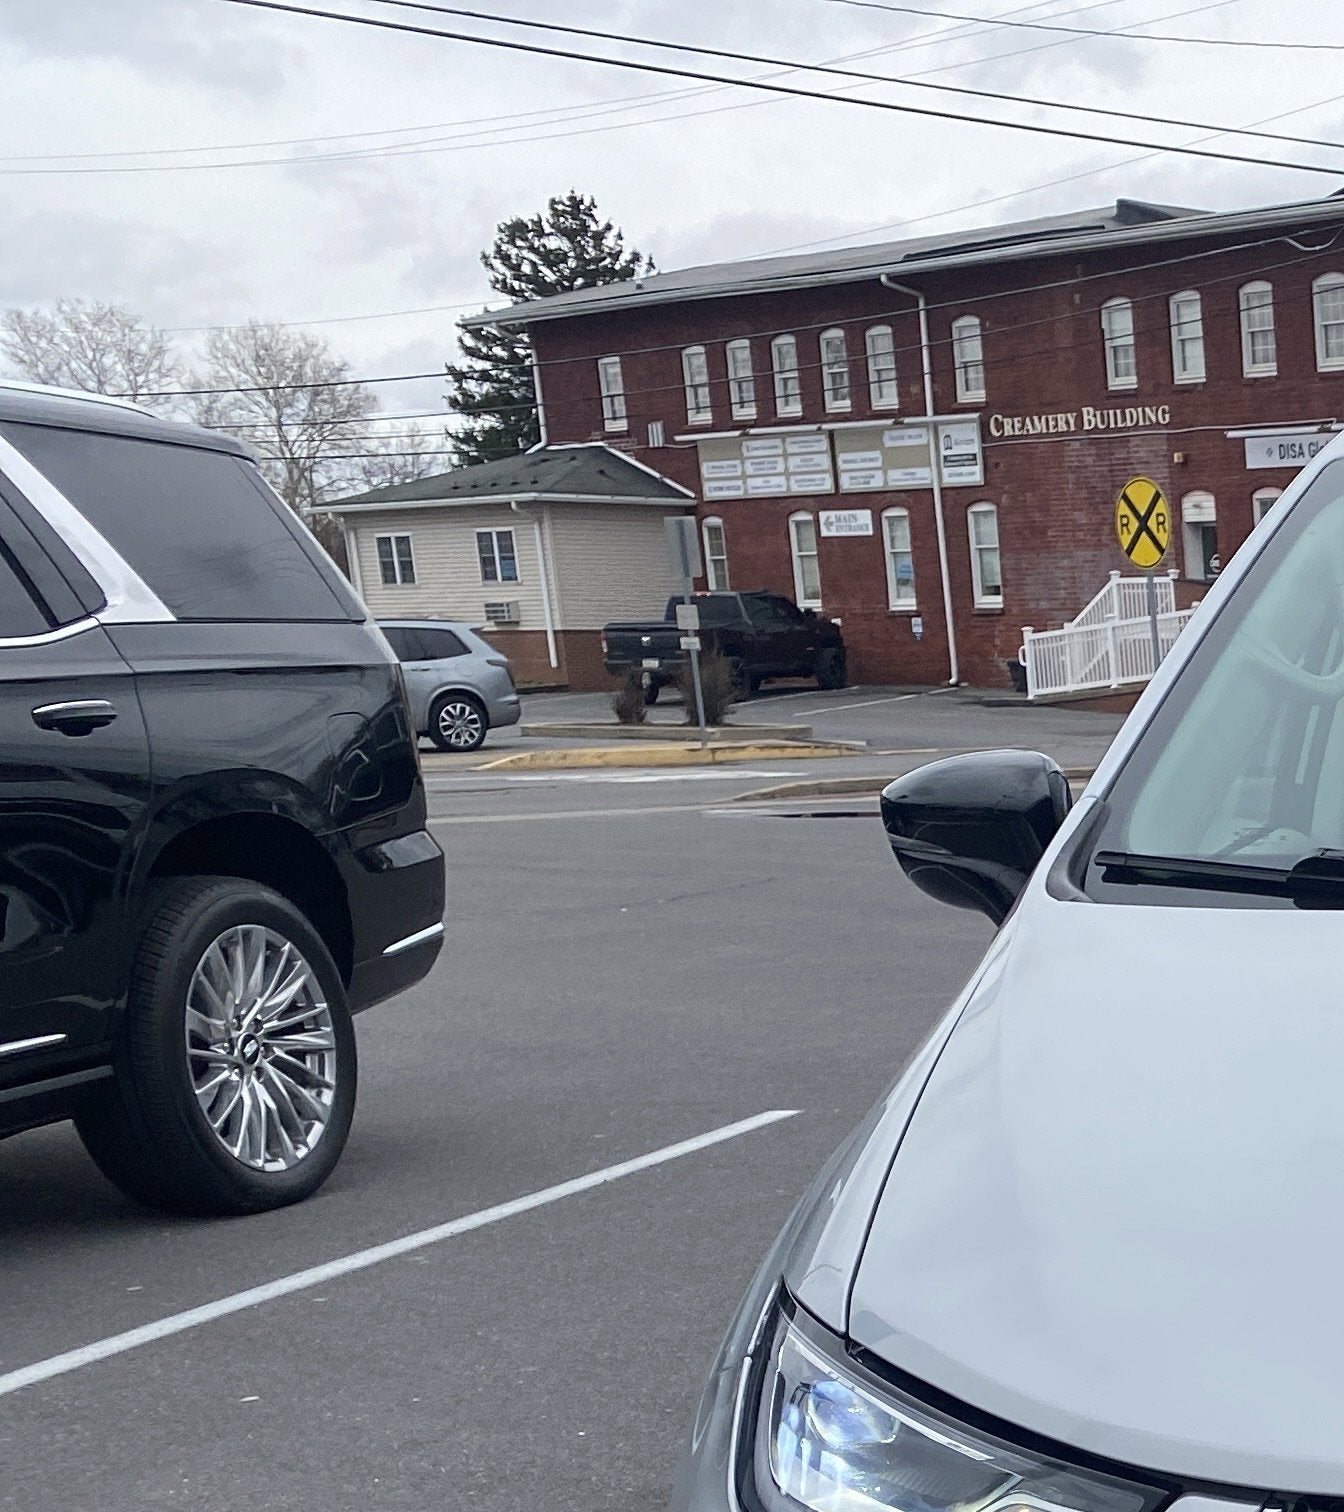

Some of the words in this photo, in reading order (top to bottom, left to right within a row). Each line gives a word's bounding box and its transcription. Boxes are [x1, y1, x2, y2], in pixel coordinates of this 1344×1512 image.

[989, 412, 1078, 437] CREAMERY
[1081, 405, 1170, 430] BUILDING
[1278, 443, 1305, 460] DISA
[834, 513, 858, 523] MAIN
[1120, 514, 1131, 535] R
[1155, 512, 1167, 533] R
